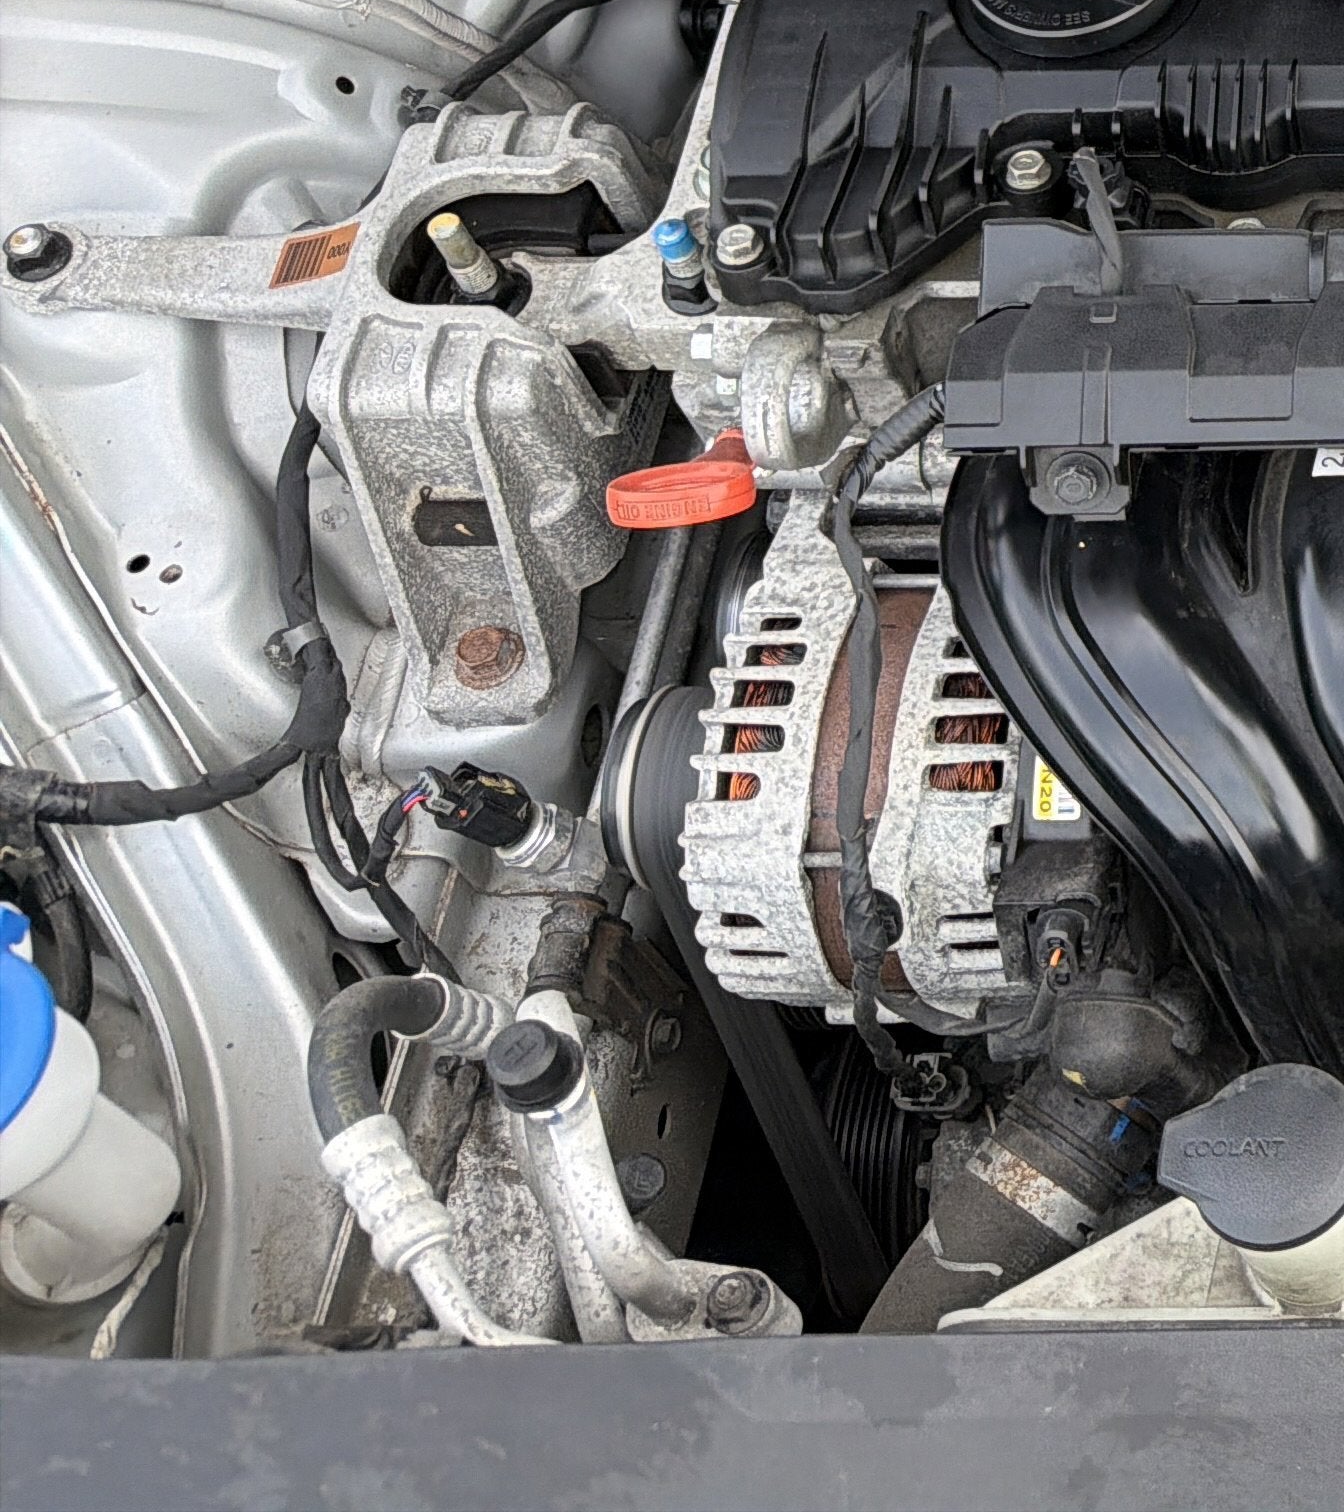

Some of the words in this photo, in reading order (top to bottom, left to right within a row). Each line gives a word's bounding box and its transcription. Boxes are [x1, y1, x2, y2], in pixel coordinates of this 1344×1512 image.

[1065, 10, 1091, 27] SEE
[617, 500, 642, 520] OIL
[645, 498, 710, 521] ENGINE
[1182, 1136, 1286, 1160] COOLANT
